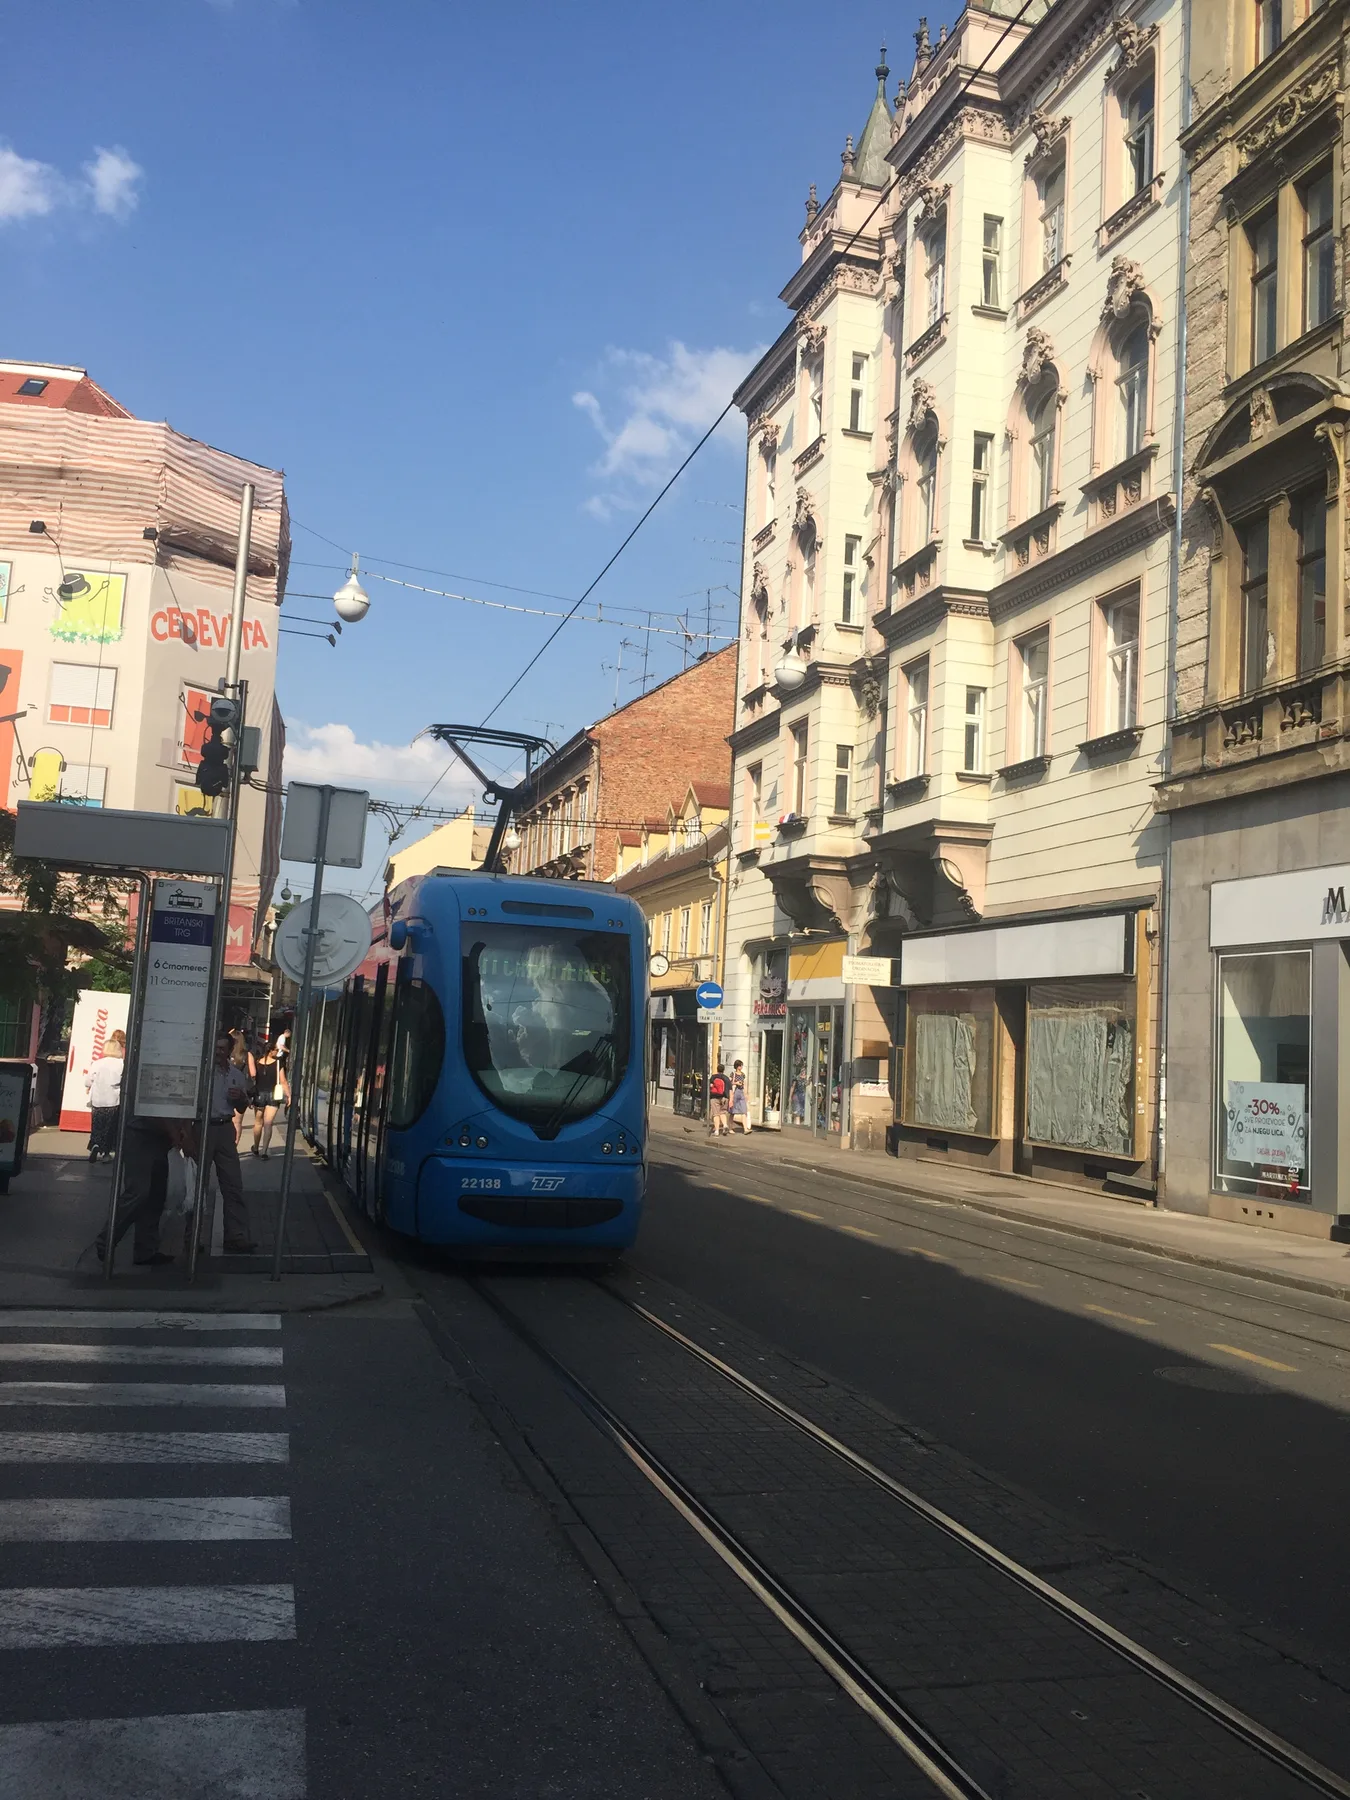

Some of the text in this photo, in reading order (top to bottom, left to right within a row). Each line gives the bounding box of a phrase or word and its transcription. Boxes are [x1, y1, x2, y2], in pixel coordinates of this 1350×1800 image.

[151, 607, 268, 650] CEDEVTA
[1325, 886, 1350, 914] M
[164, 916, 203, 928] BRITANSKI
[174, 928, 191, 938] TRG
[154, 958, 208, 973] 6 Črnomerec
[150, 975, 159, 986] 11
[1248, 1099, 1280, 1116] -30%
[1244, 1116, 1254, 1124] SVE
[1252, 1127, 1271, 1136] NJEGU
[461, 1176, 566, 1191] 22138 ZET
